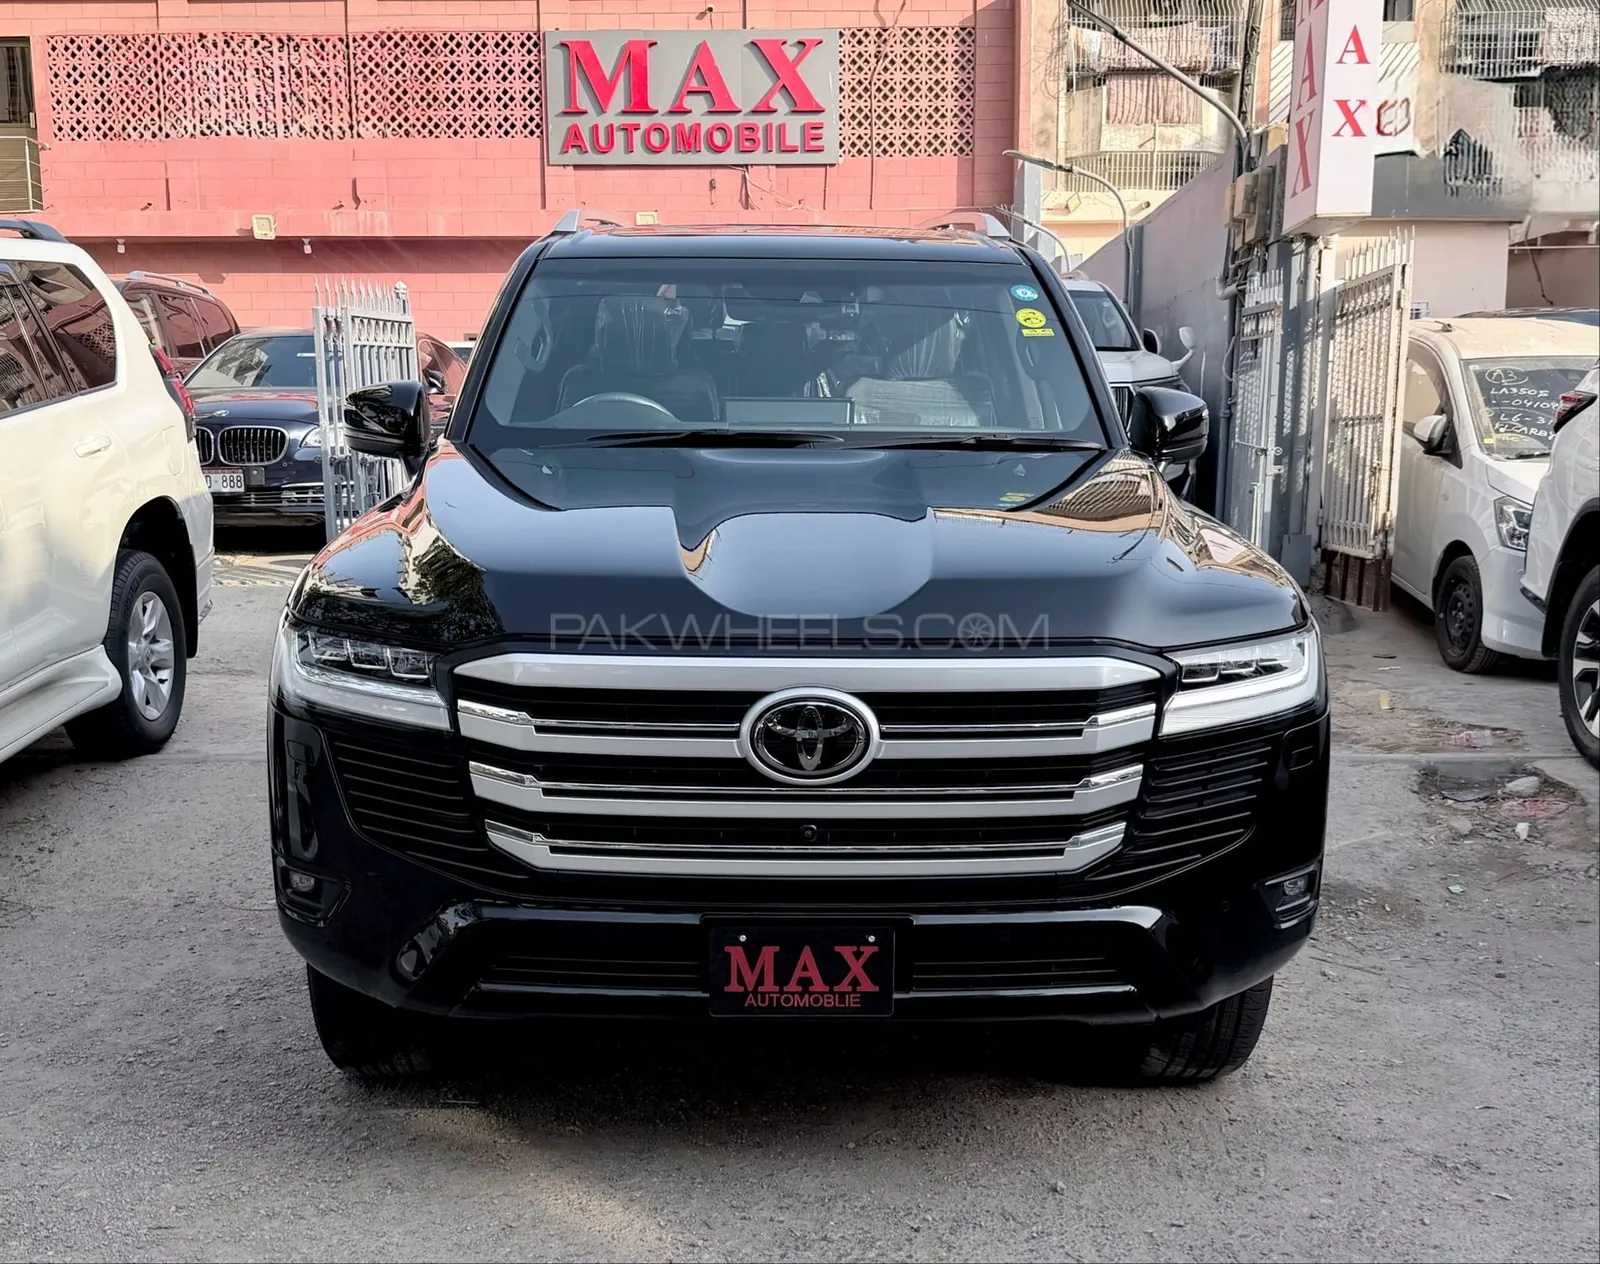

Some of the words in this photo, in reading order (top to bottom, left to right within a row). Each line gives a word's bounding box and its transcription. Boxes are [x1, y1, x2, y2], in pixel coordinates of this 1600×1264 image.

[559, 38, 825, 113] MAX
[562, 122, 826, 154] AUTOMOBILE
[221, 474, 243, 489] 888
[724, 945, 880, 992] MAX
[744, 993, 862, 1007] AUTOMOBLIE
